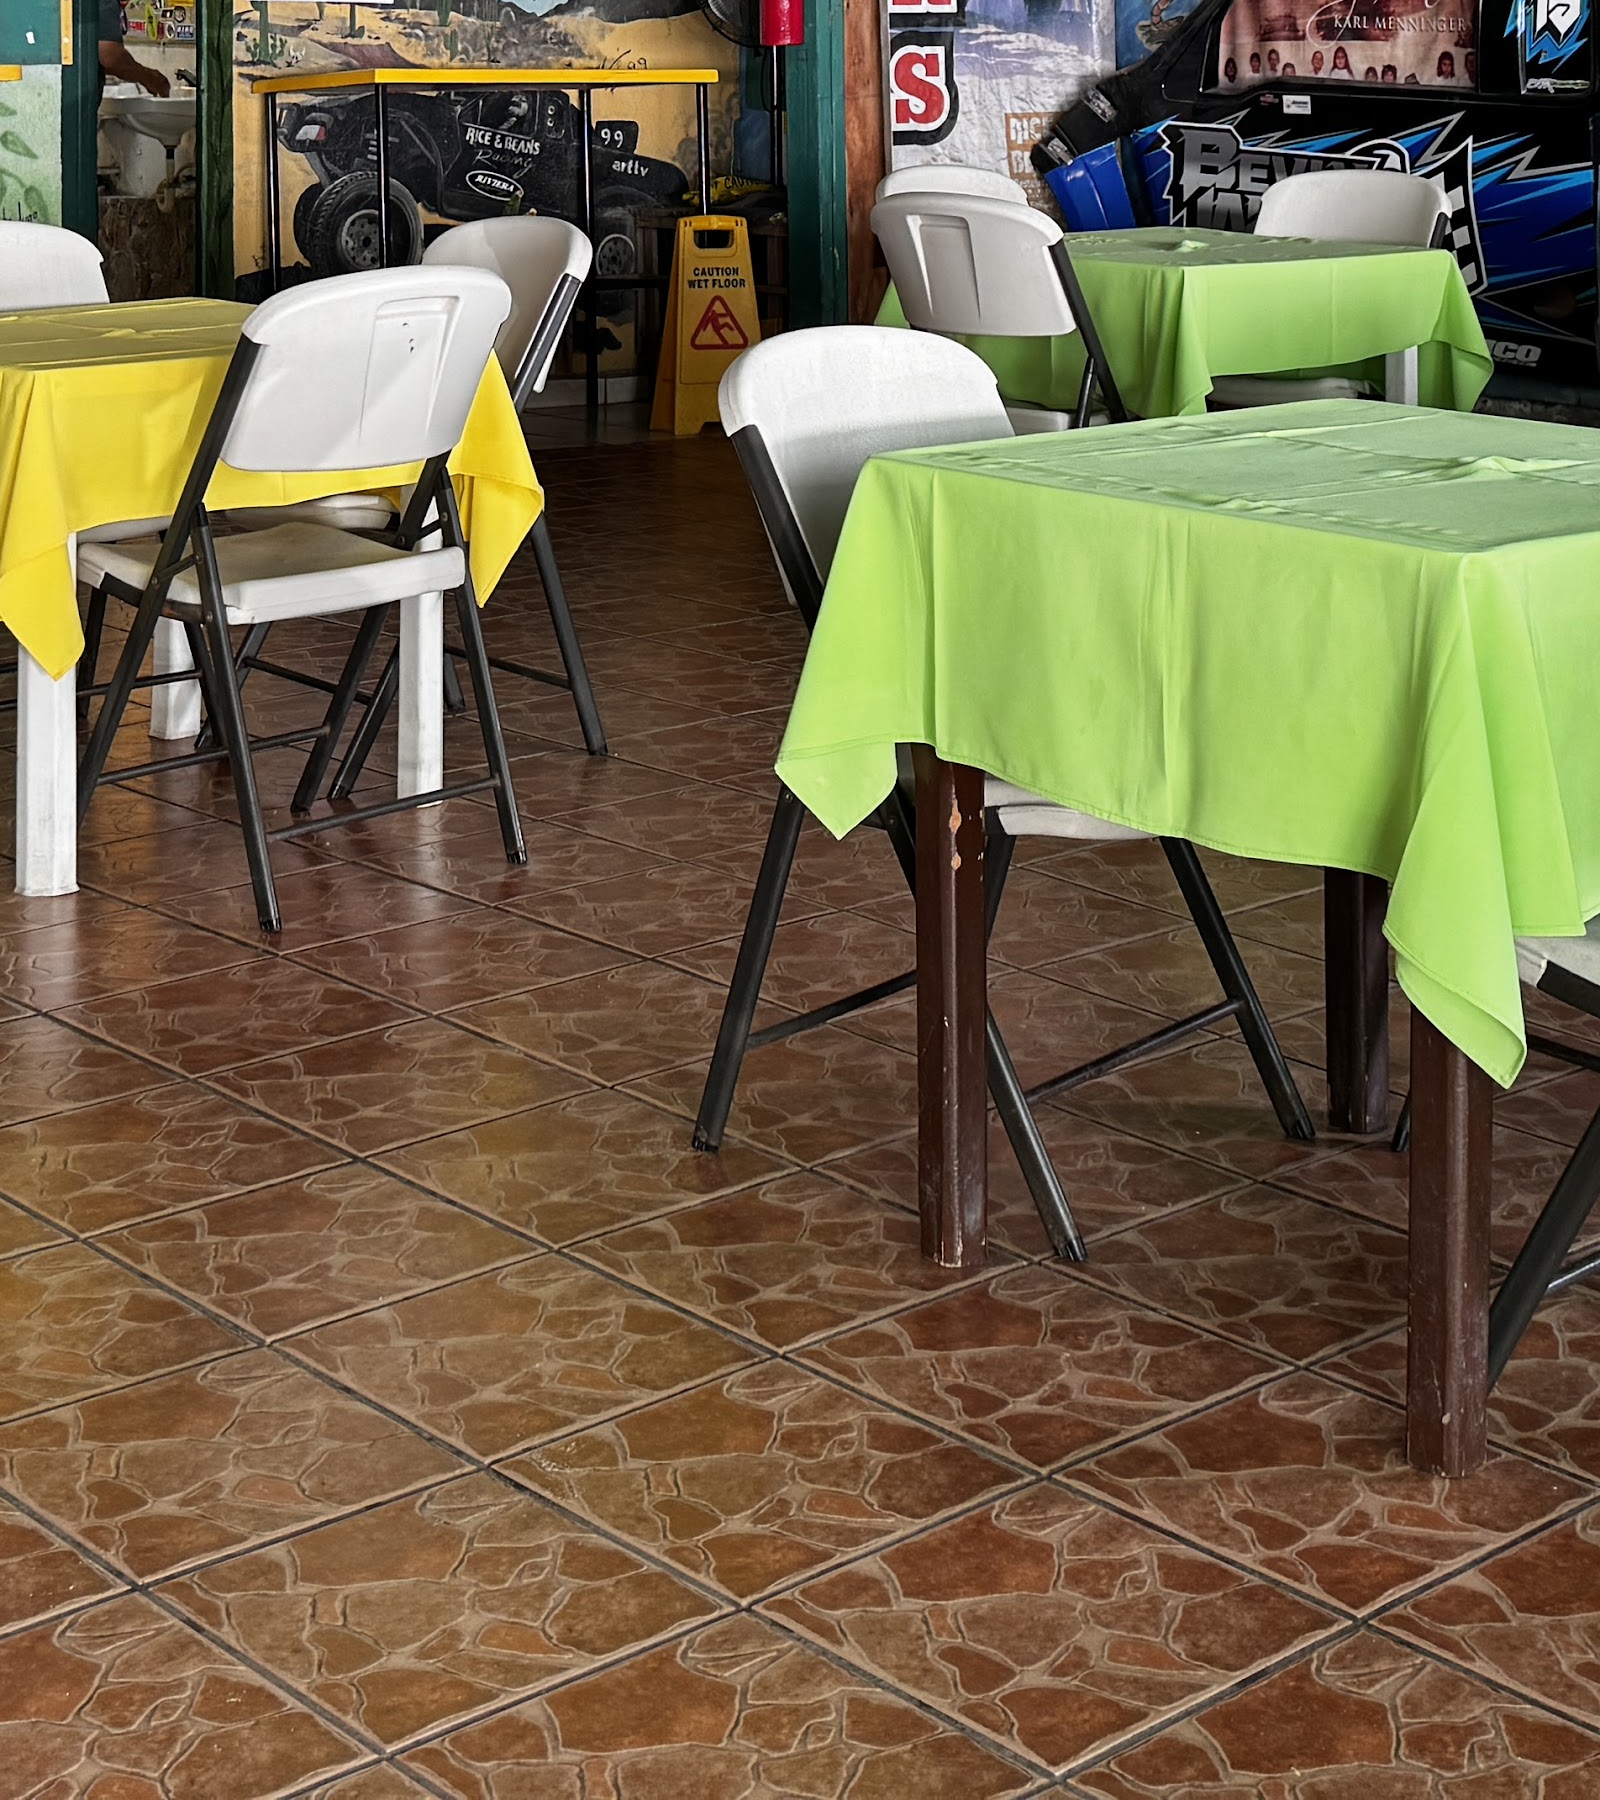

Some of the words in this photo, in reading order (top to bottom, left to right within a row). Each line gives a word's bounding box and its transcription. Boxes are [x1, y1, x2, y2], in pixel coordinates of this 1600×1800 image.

[1334, 14, 1369, 29] KARL
[1375, 16, 1466, 33] MENNINGER
[466, 127, 492, 147] RICE
[494, 134, 503, 149] &
[504, 136, 540, 156] BEANS
[601, 128, 624, 148] 99
[693, 266, 739, 278] CAUTION
[687, 279, 709, 290] WET
[712, 278, 746, 289] FLOOR
